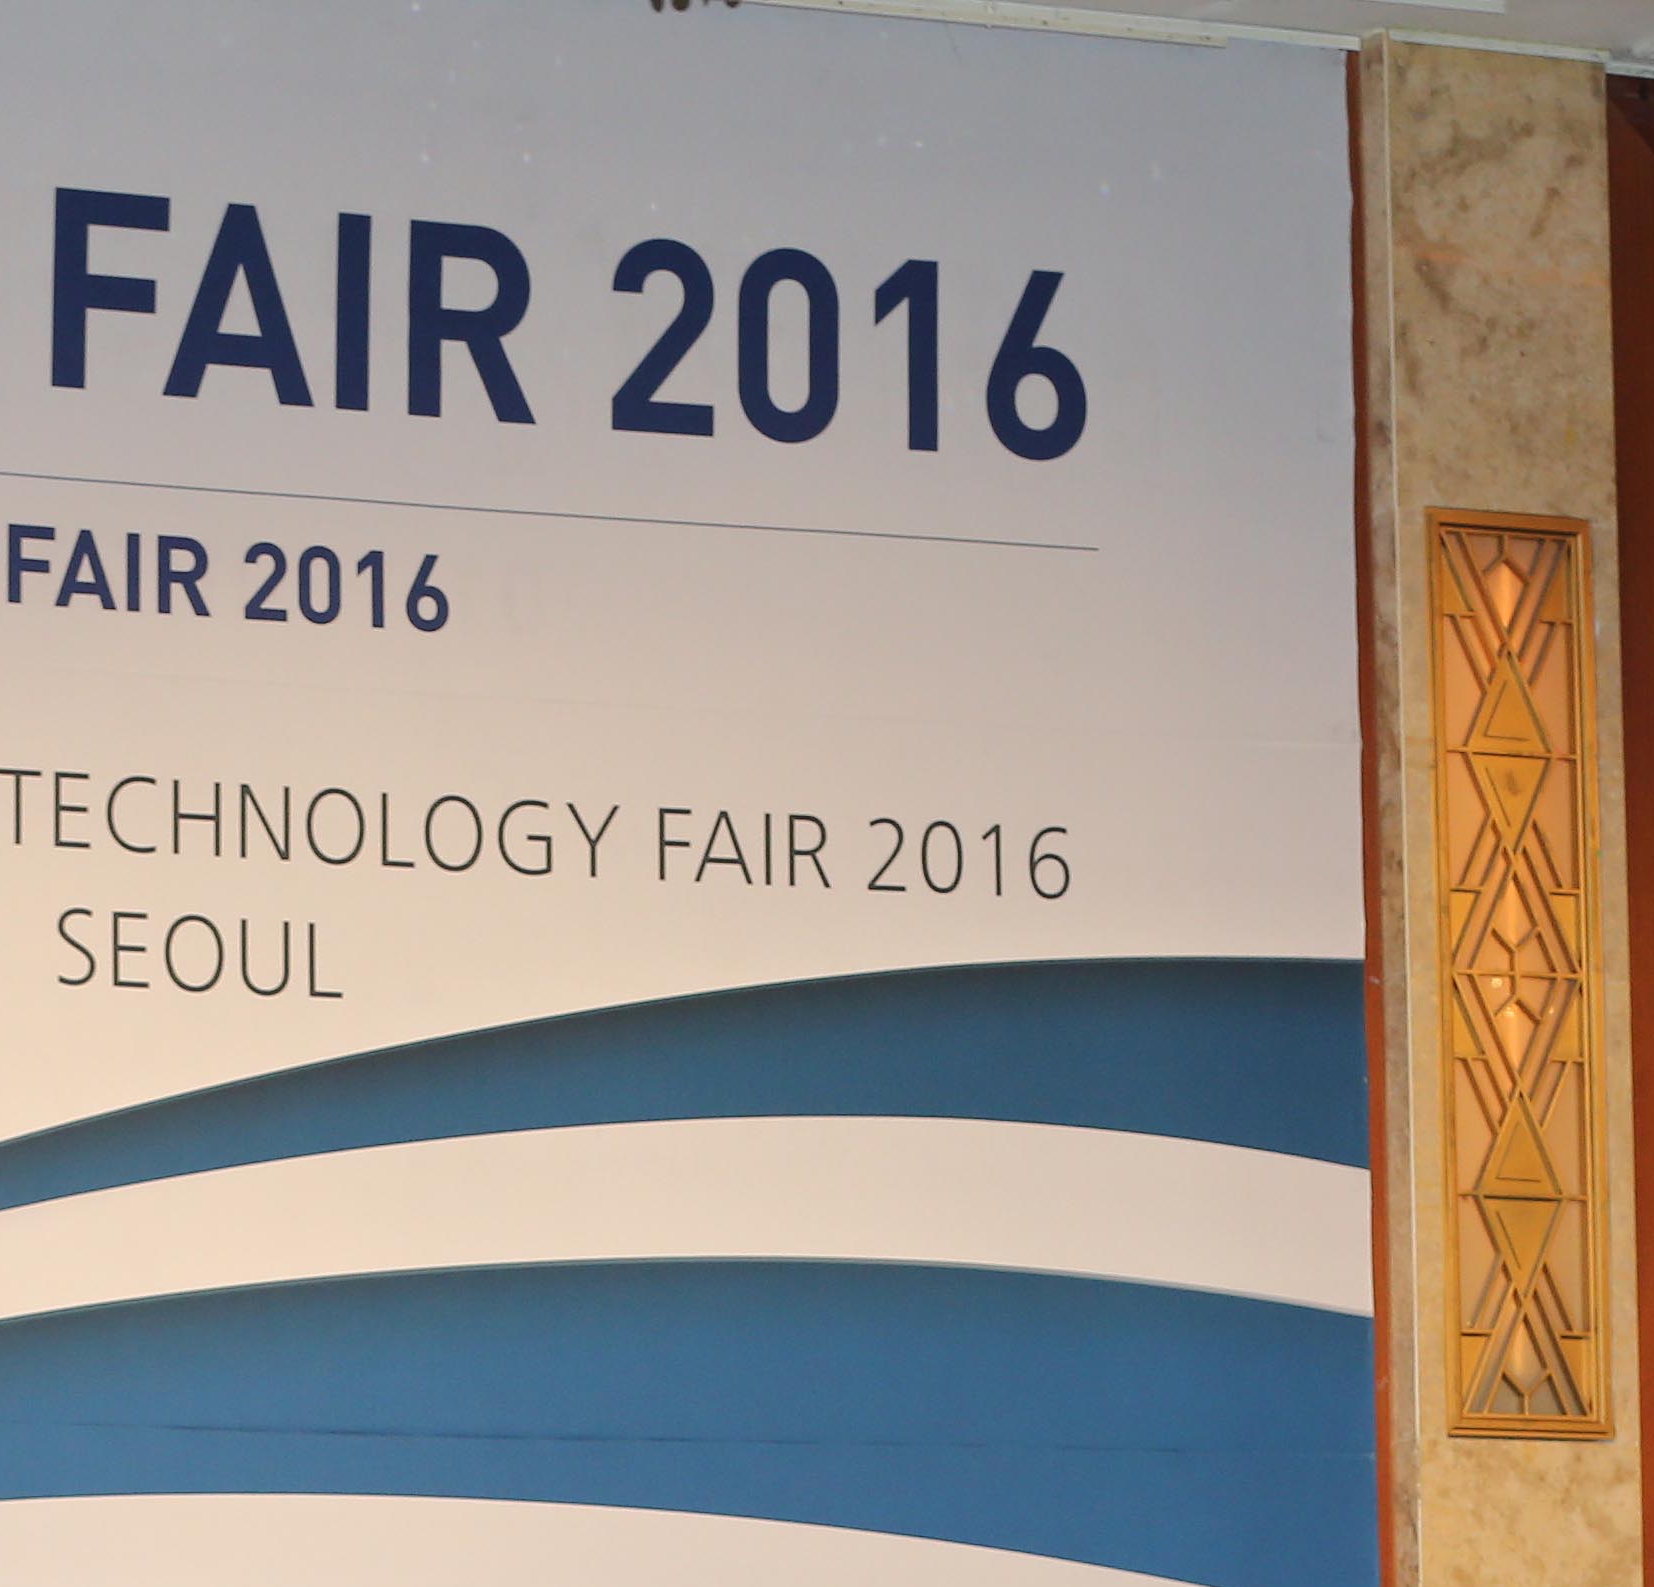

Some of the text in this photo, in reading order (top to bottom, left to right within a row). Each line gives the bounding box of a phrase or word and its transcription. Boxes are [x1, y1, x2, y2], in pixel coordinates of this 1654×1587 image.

[50, 186, 537, 425] FAIR
[611, 237, 1088, 462] 2016
[5, 522, 212, 617] FAIR
[242, 541, 451, 633] 2016
[654, 806, 832, 890] FAIR
[866, 817, 1073, 900] 2016
[56, 905, 345, 1000] SEOUL
